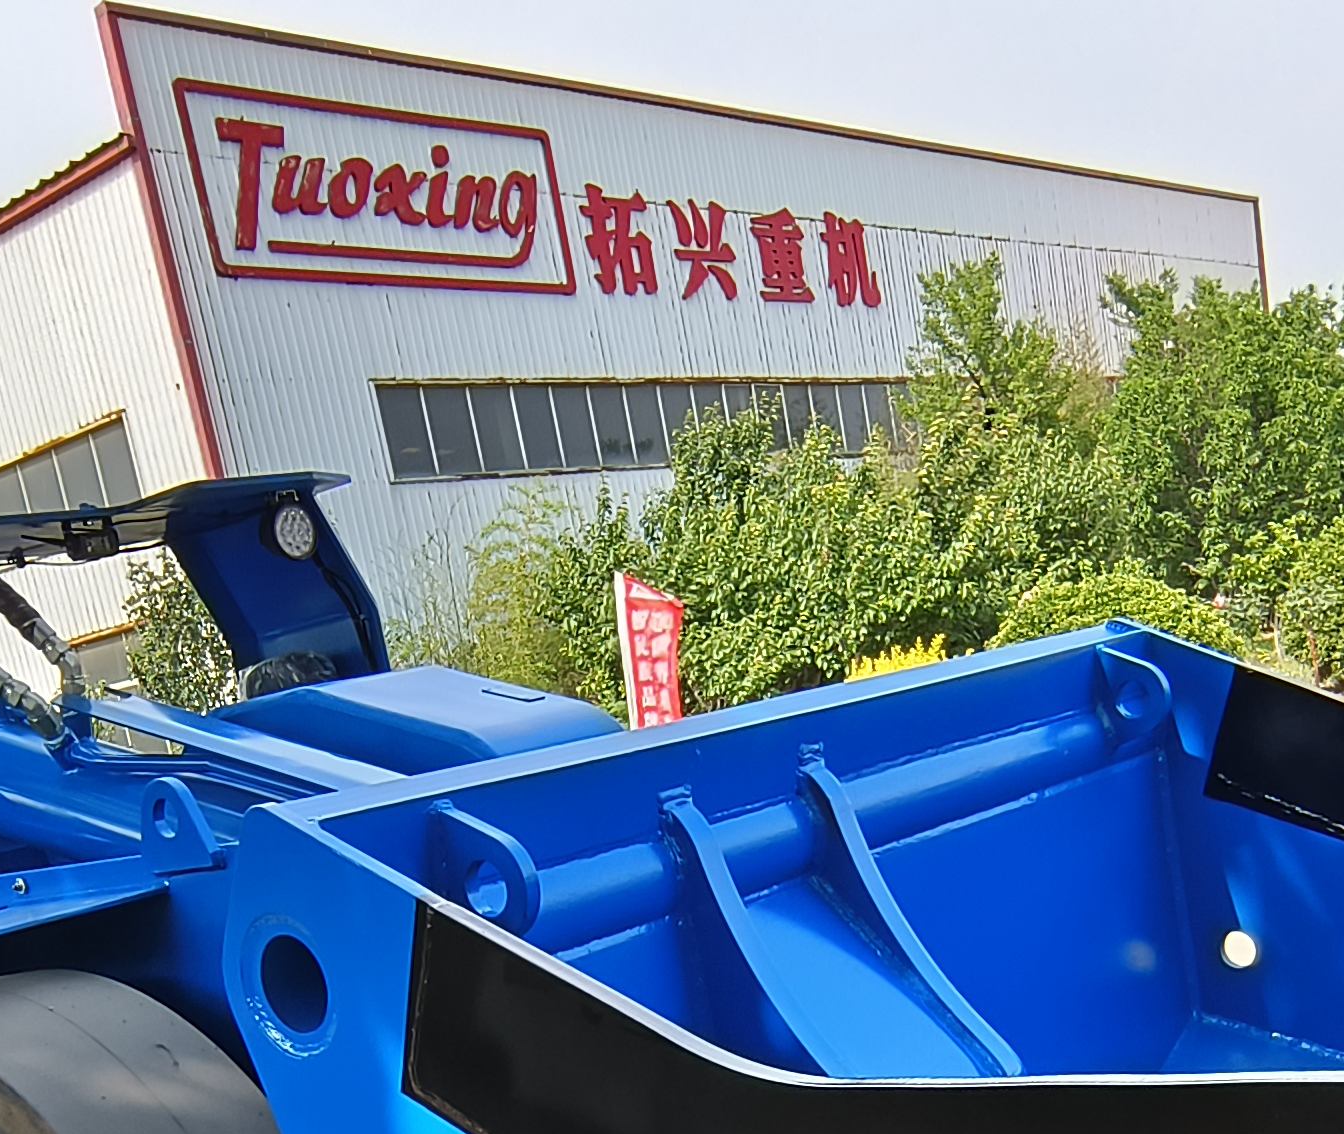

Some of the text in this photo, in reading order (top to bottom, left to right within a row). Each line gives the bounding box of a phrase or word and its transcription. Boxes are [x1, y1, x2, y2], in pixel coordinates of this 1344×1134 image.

[215, 117, 537, 267] Tuoxing
[579, 183, 881, 308] 拓兴重机
